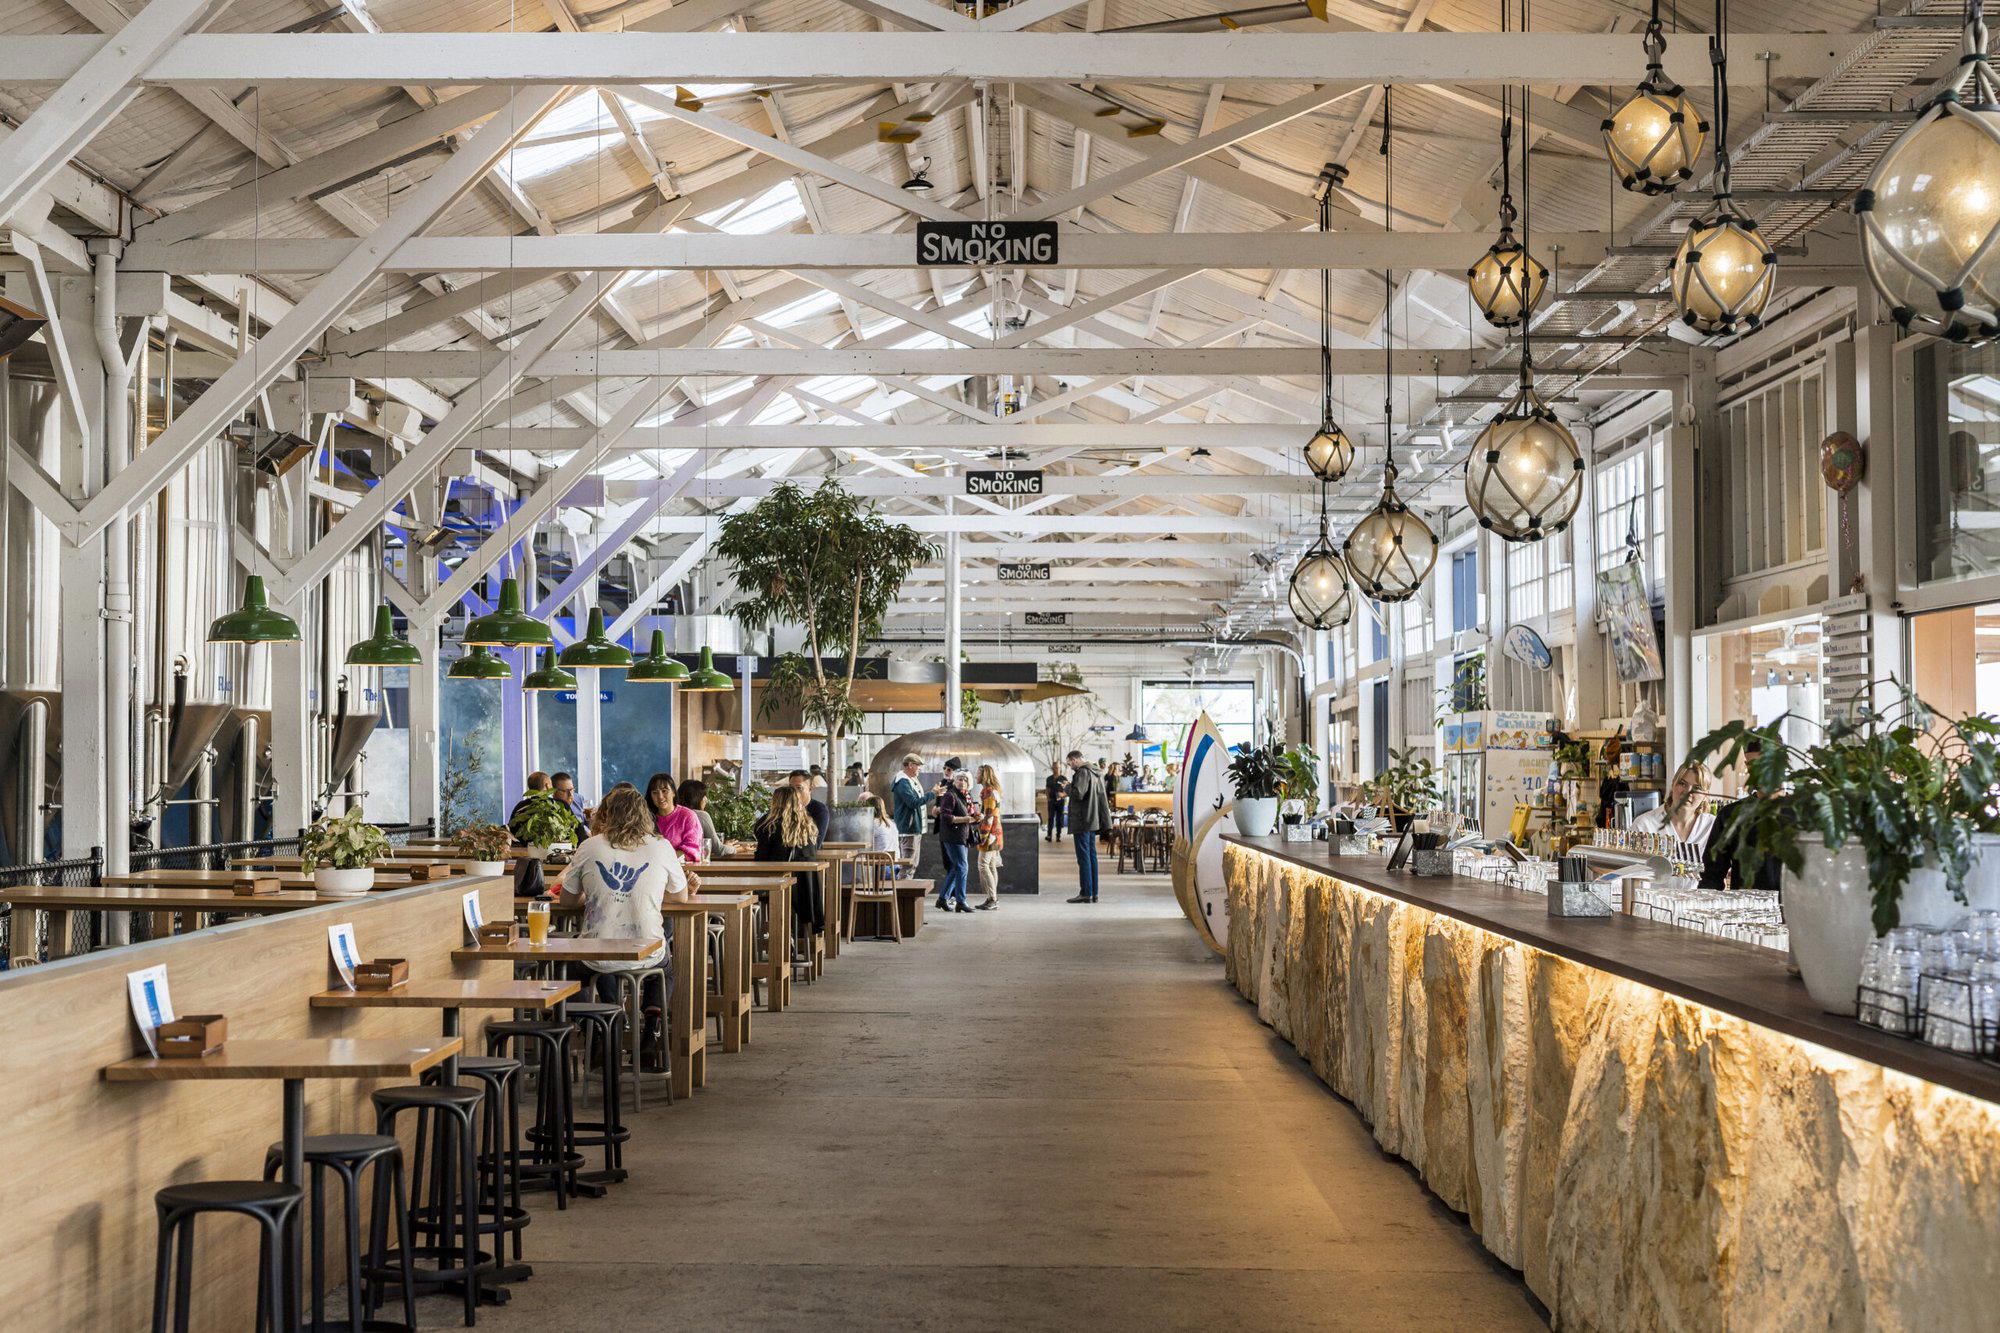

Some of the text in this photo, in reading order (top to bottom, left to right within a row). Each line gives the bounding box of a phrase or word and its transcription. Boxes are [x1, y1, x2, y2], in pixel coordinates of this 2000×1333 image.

[971, 223, 1006, 239] NO
[922, 232, 1052, 262] SMOKING
[995, 471, 1015, 480] NO
[969, 476, 1040, 493] SMOKING
[1000, 567, 1049, 579] SMOKING
[1026, 614, 1064, 624] SMOKING
